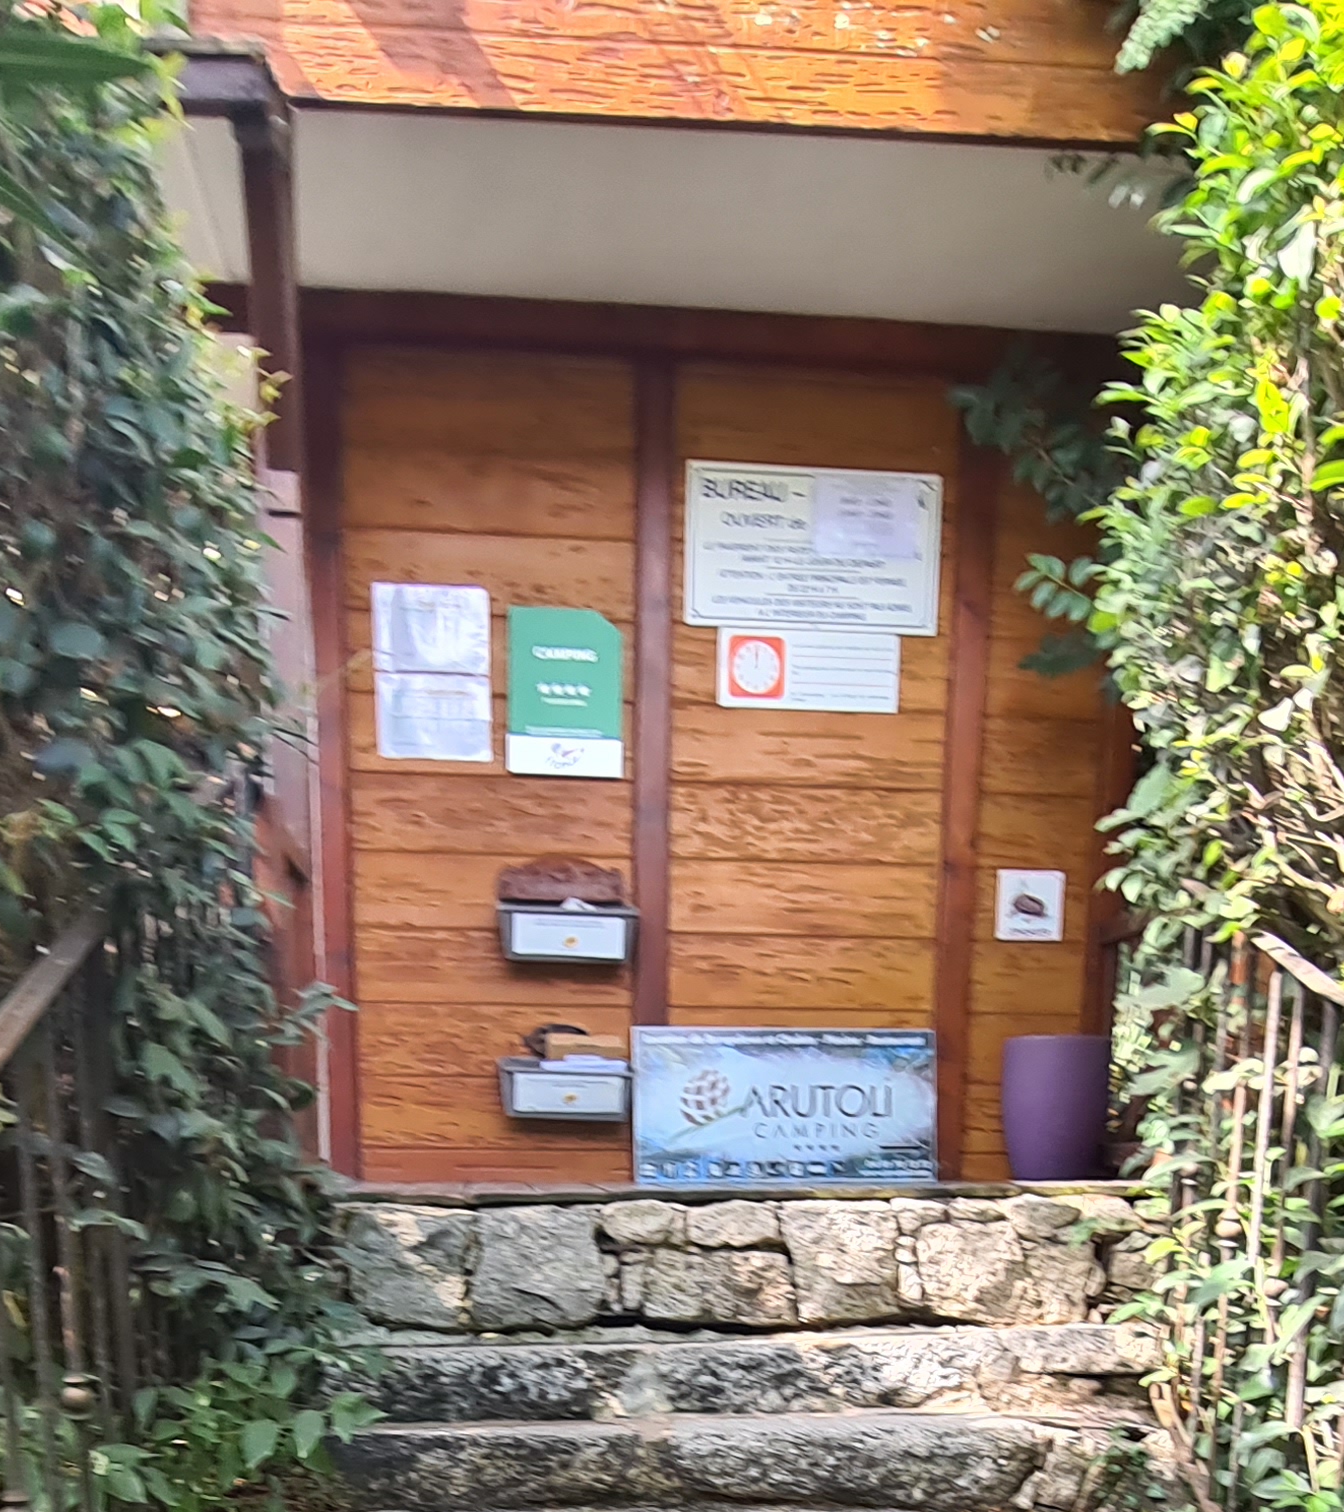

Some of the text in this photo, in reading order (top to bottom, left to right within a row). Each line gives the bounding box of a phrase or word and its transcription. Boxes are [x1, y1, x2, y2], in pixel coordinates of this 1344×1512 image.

[700, 477, 789, 503] BUREAU
[531, 645, 599, 664] CAMPING
[753, 1121, 880, 1140] CAMPING
